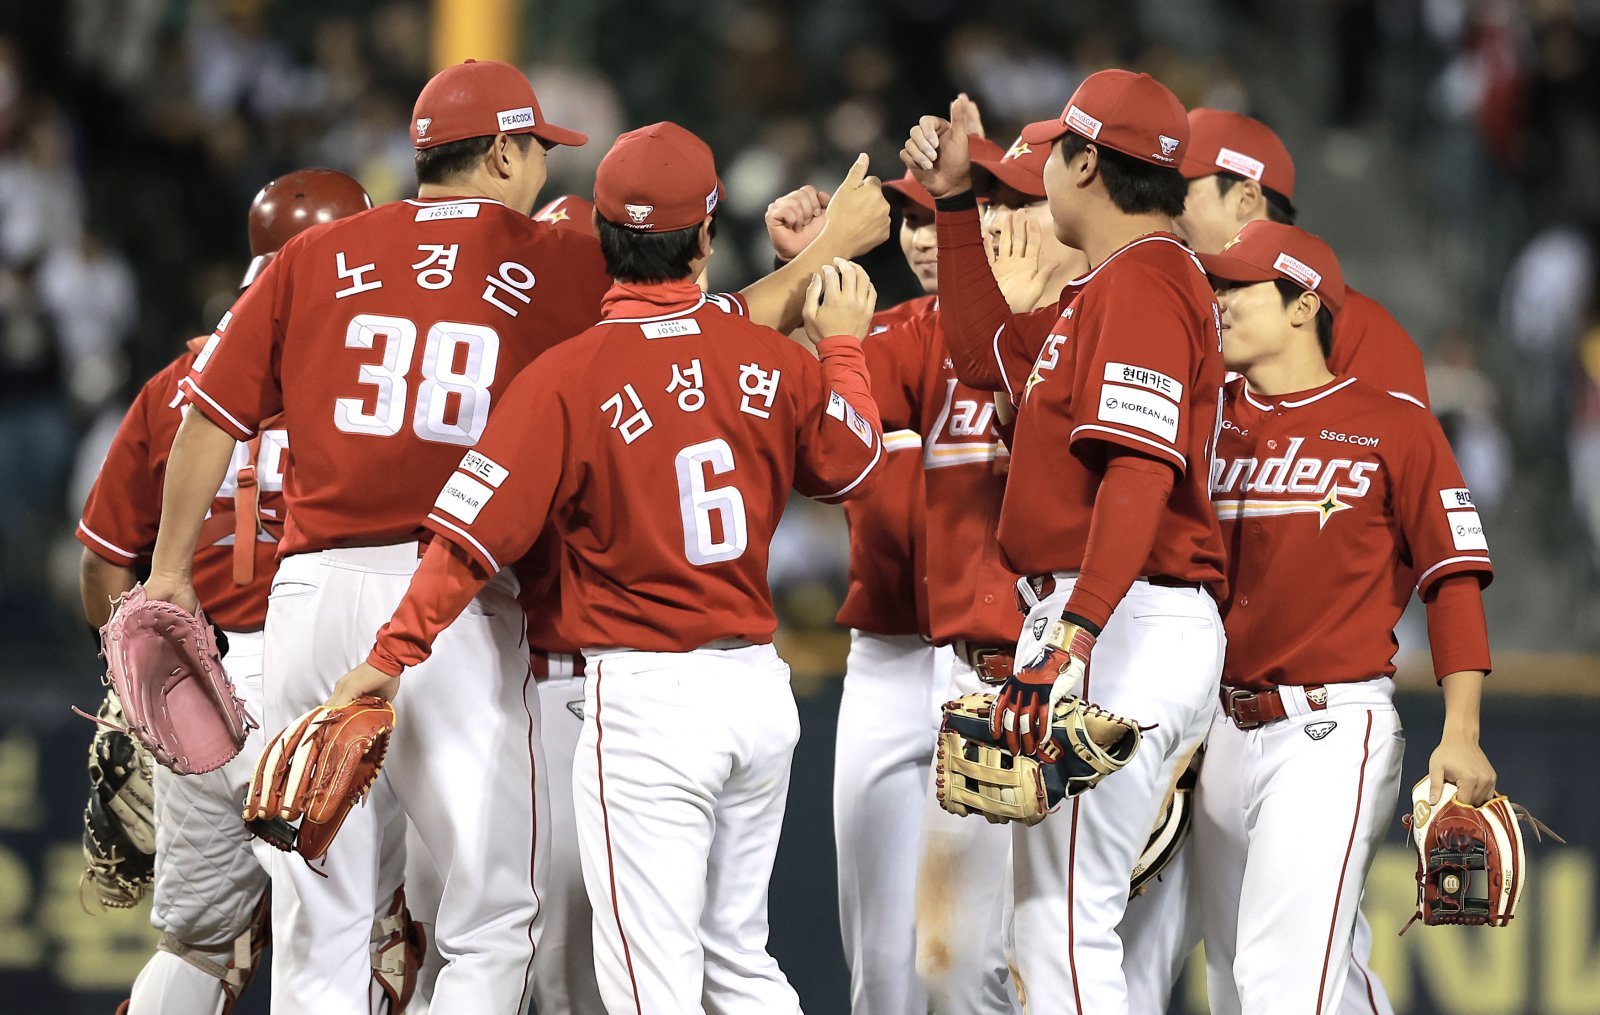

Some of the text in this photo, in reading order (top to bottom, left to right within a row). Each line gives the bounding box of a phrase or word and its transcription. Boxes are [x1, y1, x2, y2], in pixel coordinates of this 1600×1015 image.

[501, 113, 533, 126] PEACOCK
[429, 209, 464, 218] JOSUN
[1282, 256, 1318, 280] SHINSEGAE
[657, 324, 688, 336] JOSUN
[333, 314, 500, 447] 38
[1122, 366, 1172, 393] 현대카드
[1121, 401, 1175, 427] KOREAN AIR
[1319, 429, 1380, 447] SSG.COM
[465, 497, 480, 509] AIR
[674, 438, 748, 566] 6
